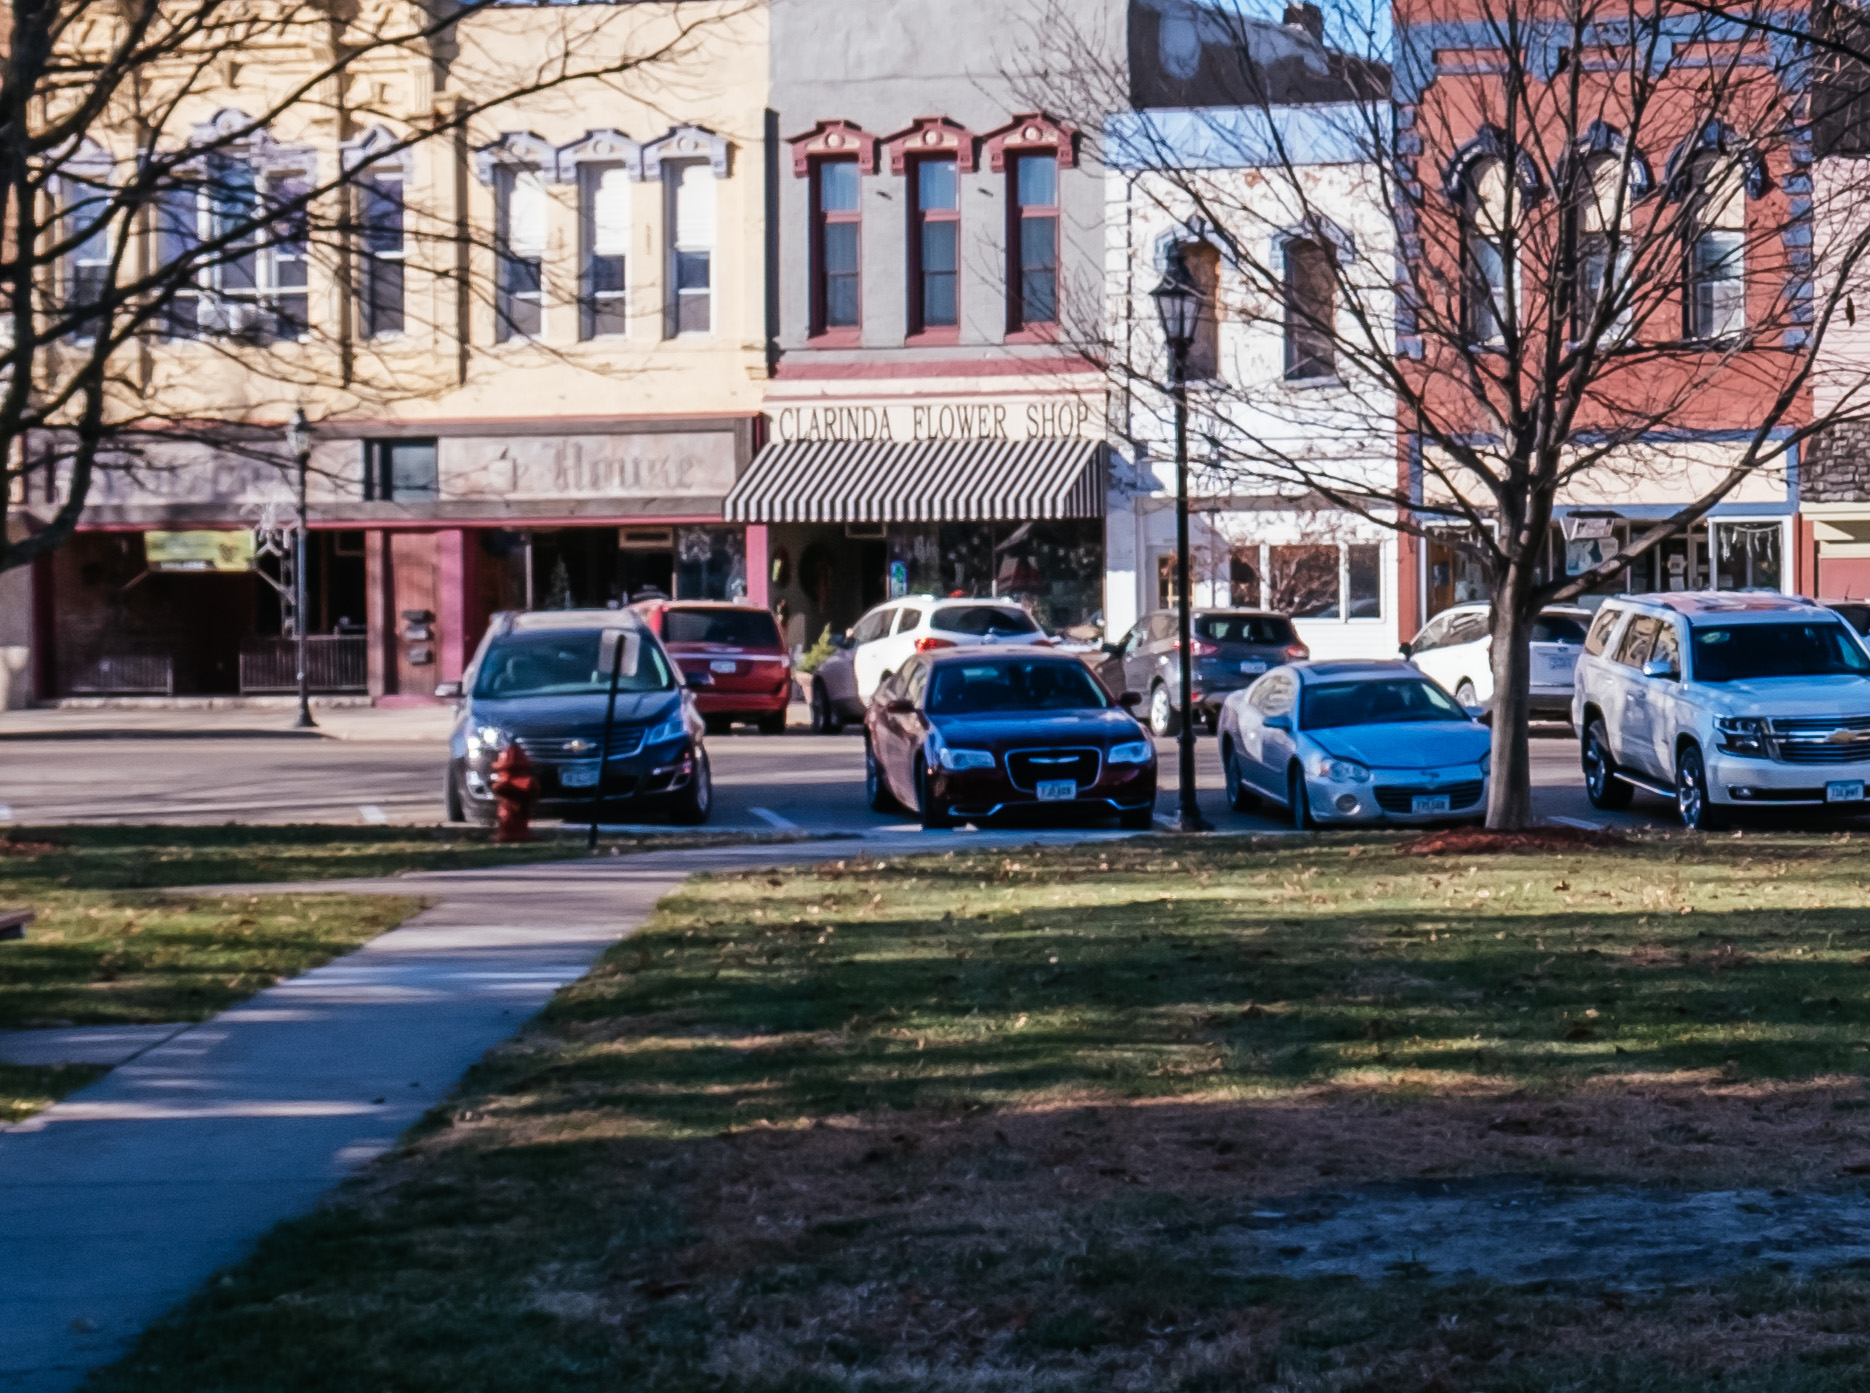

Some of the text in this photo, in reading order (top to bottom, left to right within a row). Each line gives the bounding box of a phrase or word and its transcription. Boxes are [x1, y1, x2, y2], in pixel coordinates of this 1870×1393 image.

[780, 403, 1089, 441] CLARINDA FLOWER SHOP
